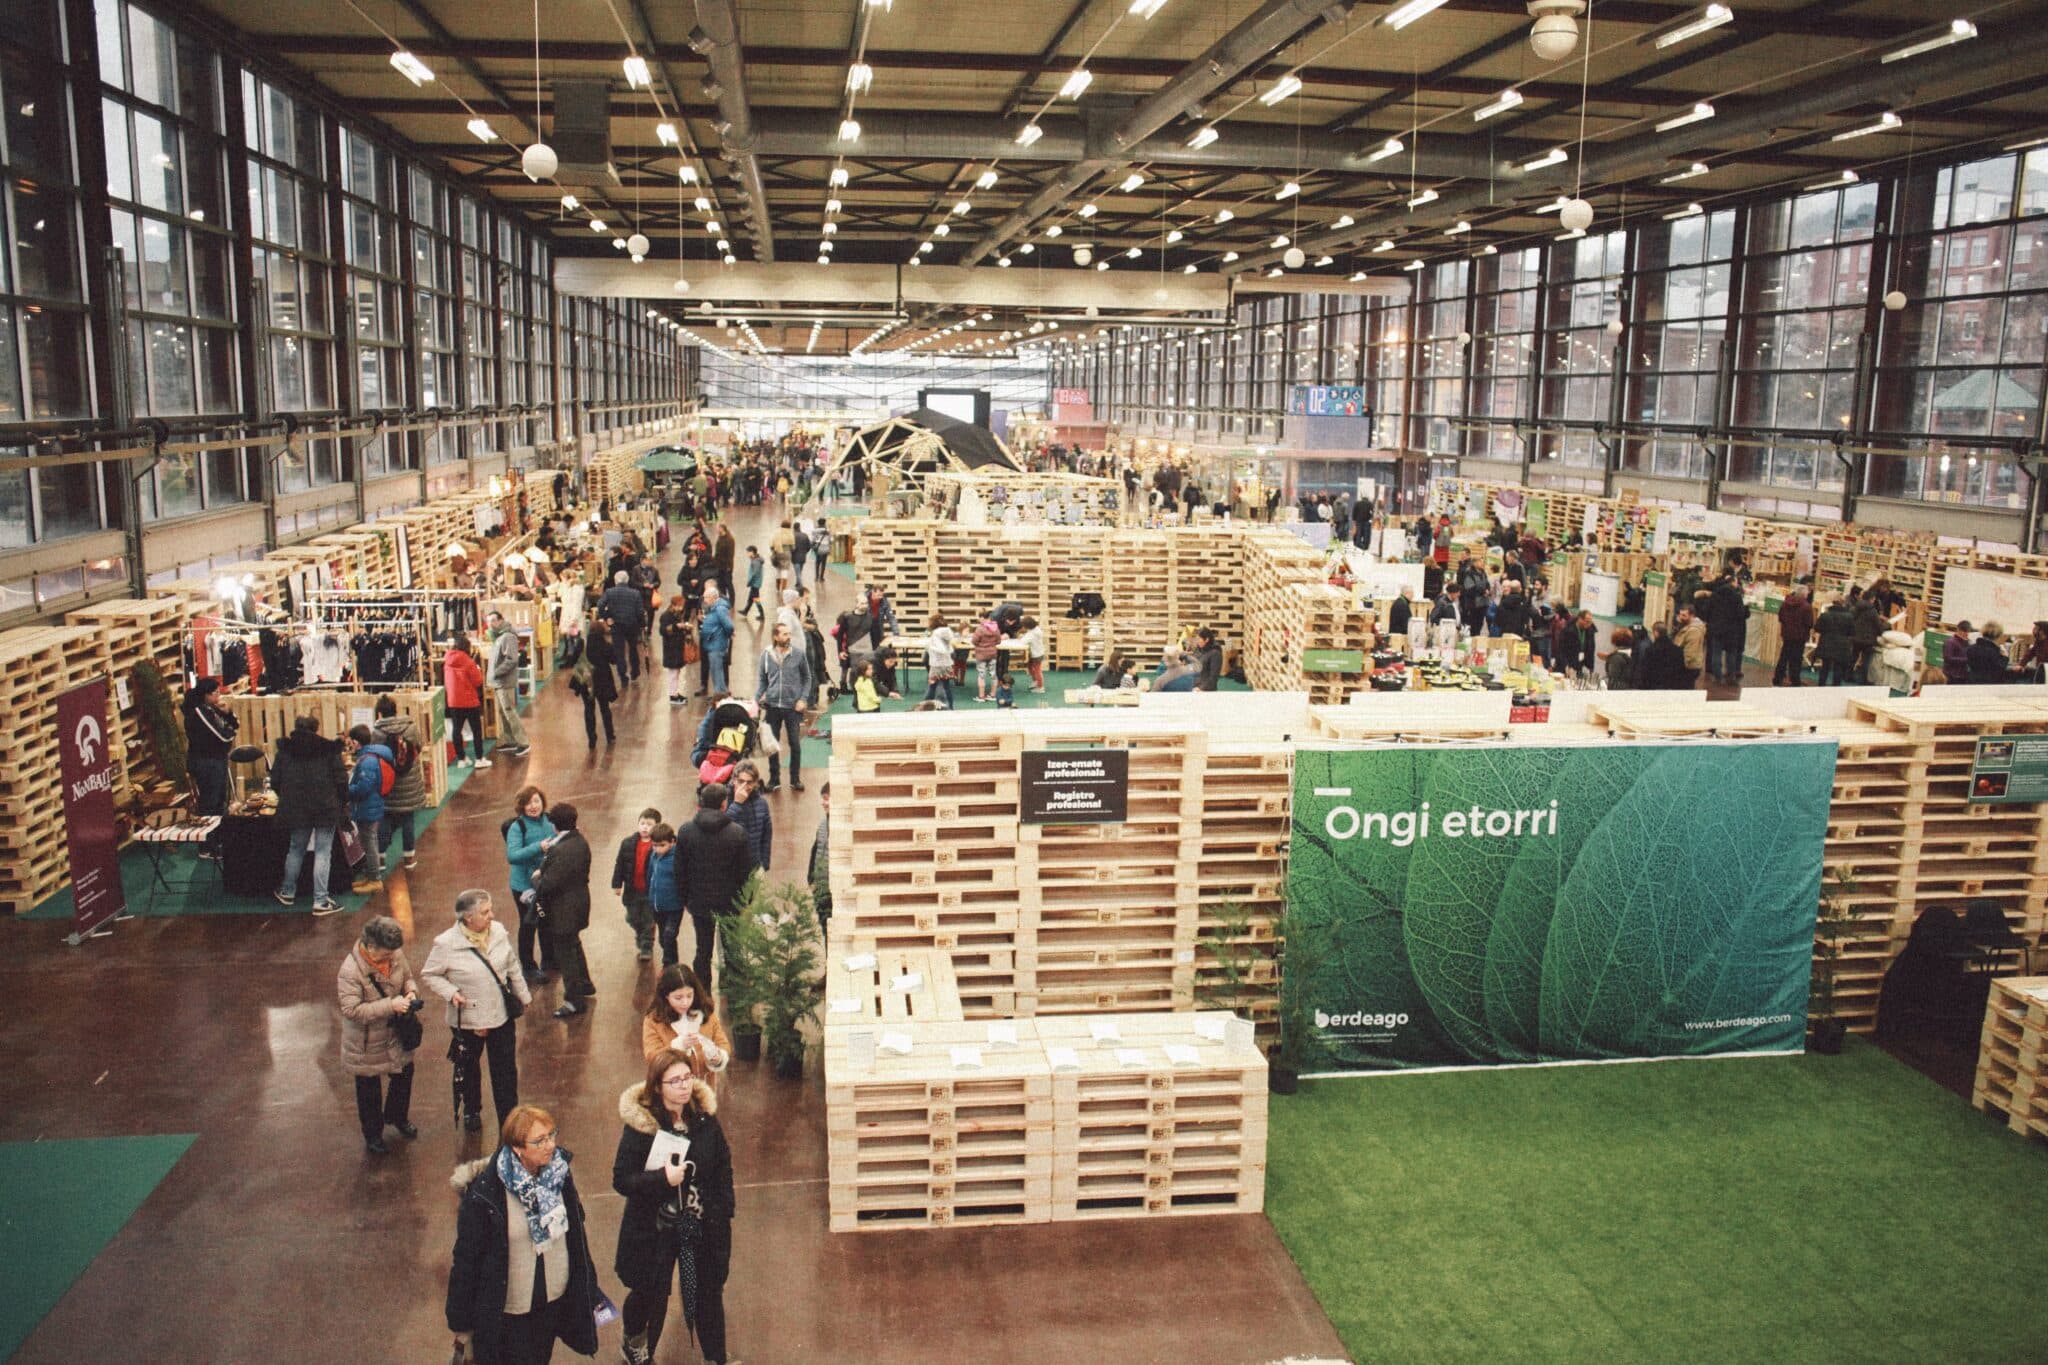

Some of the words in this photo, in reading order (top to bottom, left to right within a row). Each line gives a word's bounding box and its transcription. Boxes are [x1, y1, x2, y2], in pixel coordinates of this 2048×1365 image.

[1047, 760, 1103, 769] Izen-emate
[1044, 769, 1105, 779] profesionala
[1053, 791, 1096, 801] Registro
[1046, 800, 1102, 811] profesional
[1325, 802, 1430, 847] Ongi
[1442, 799, 1559, 837] etorri
[1314, 1008, 1409, 1029] berdeago
[1684, 1013, 1792, 1028] www.berdeago.com
